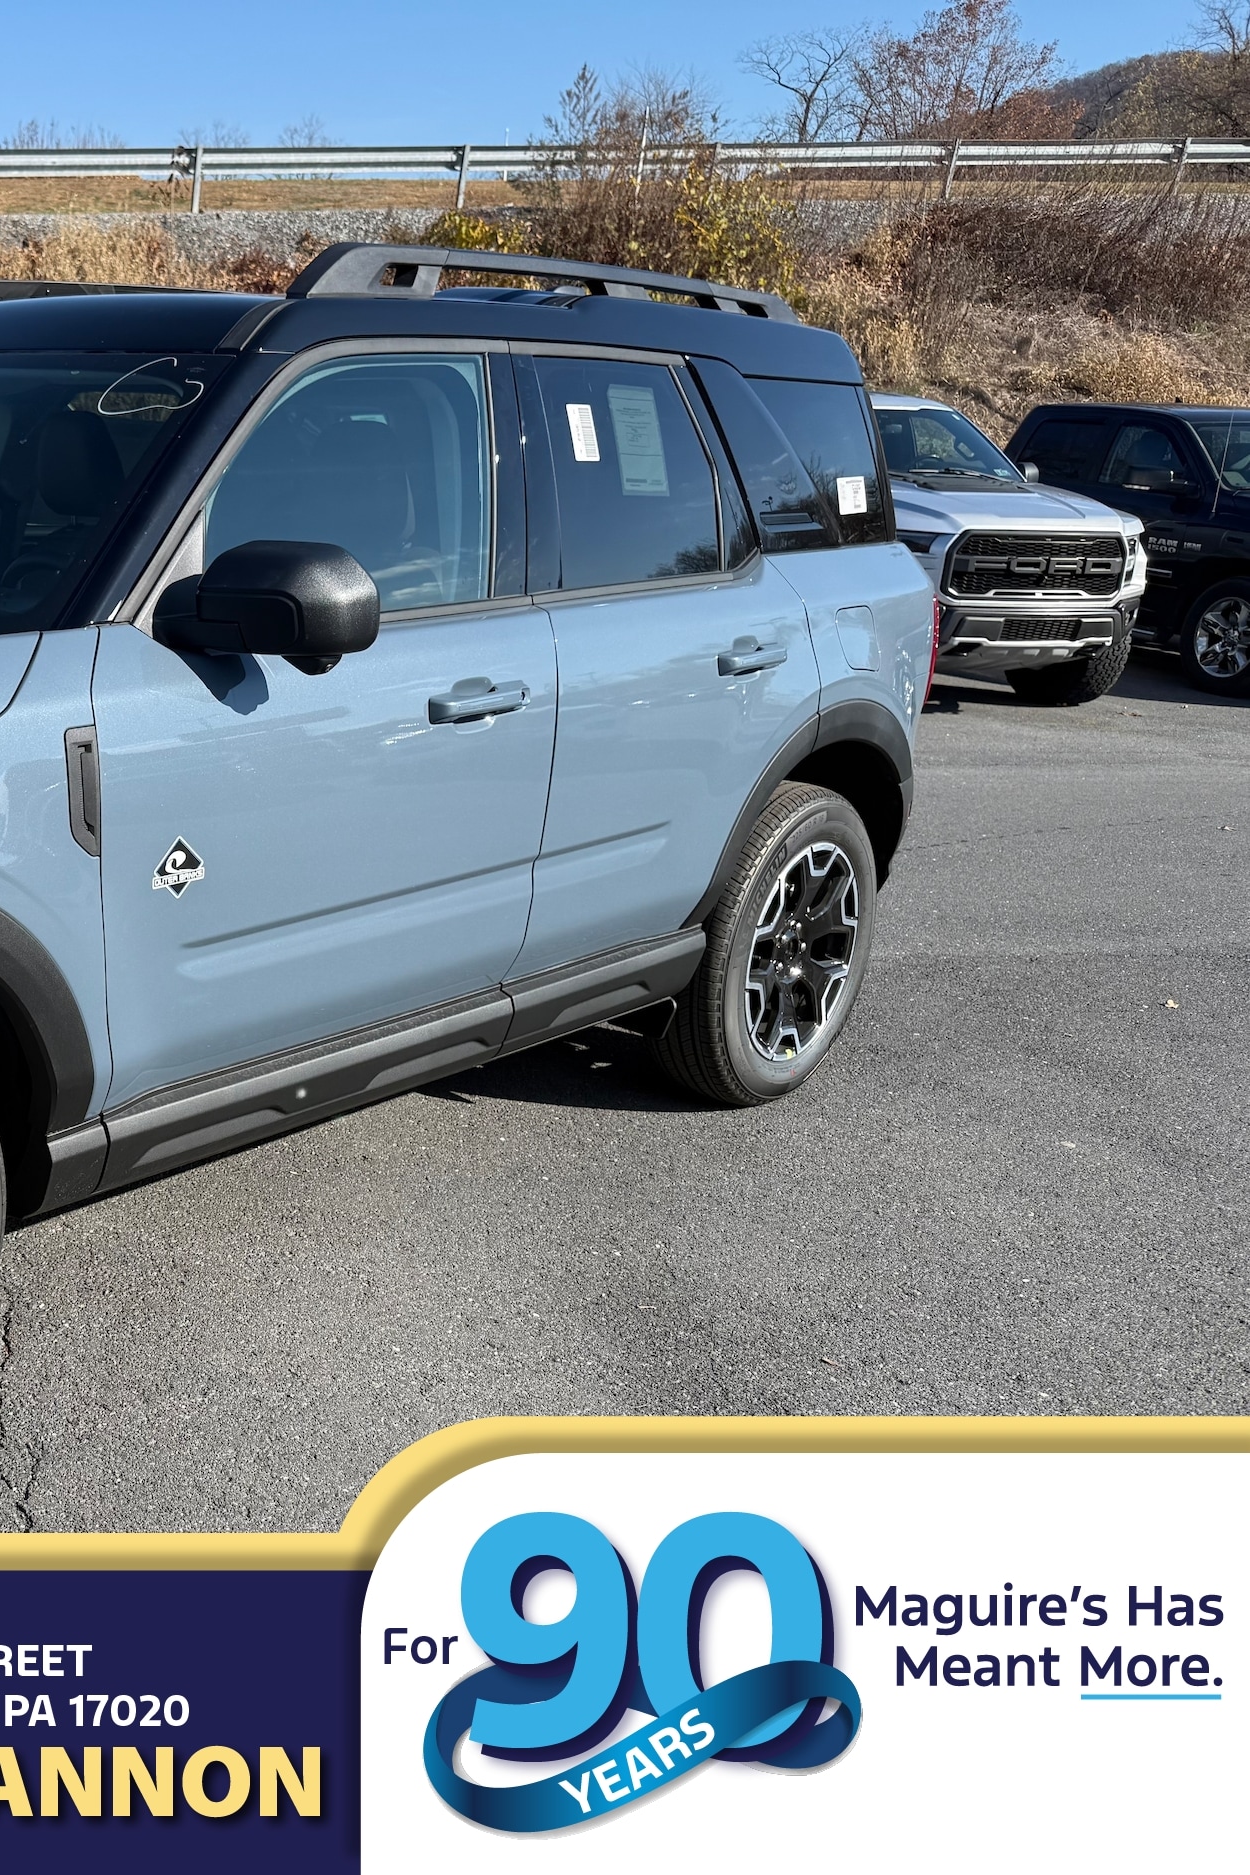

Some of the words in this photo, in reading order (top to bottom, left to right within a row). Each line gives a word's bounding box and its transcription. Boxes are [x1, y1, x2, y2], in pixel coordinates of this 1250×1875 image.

[1149, 537, 1178, 547] RAM
[956, 555, 1123, 575] FORD
[154, 875, 179, 887] OUTER
[747, 846, 787, 927] MICHELIN
